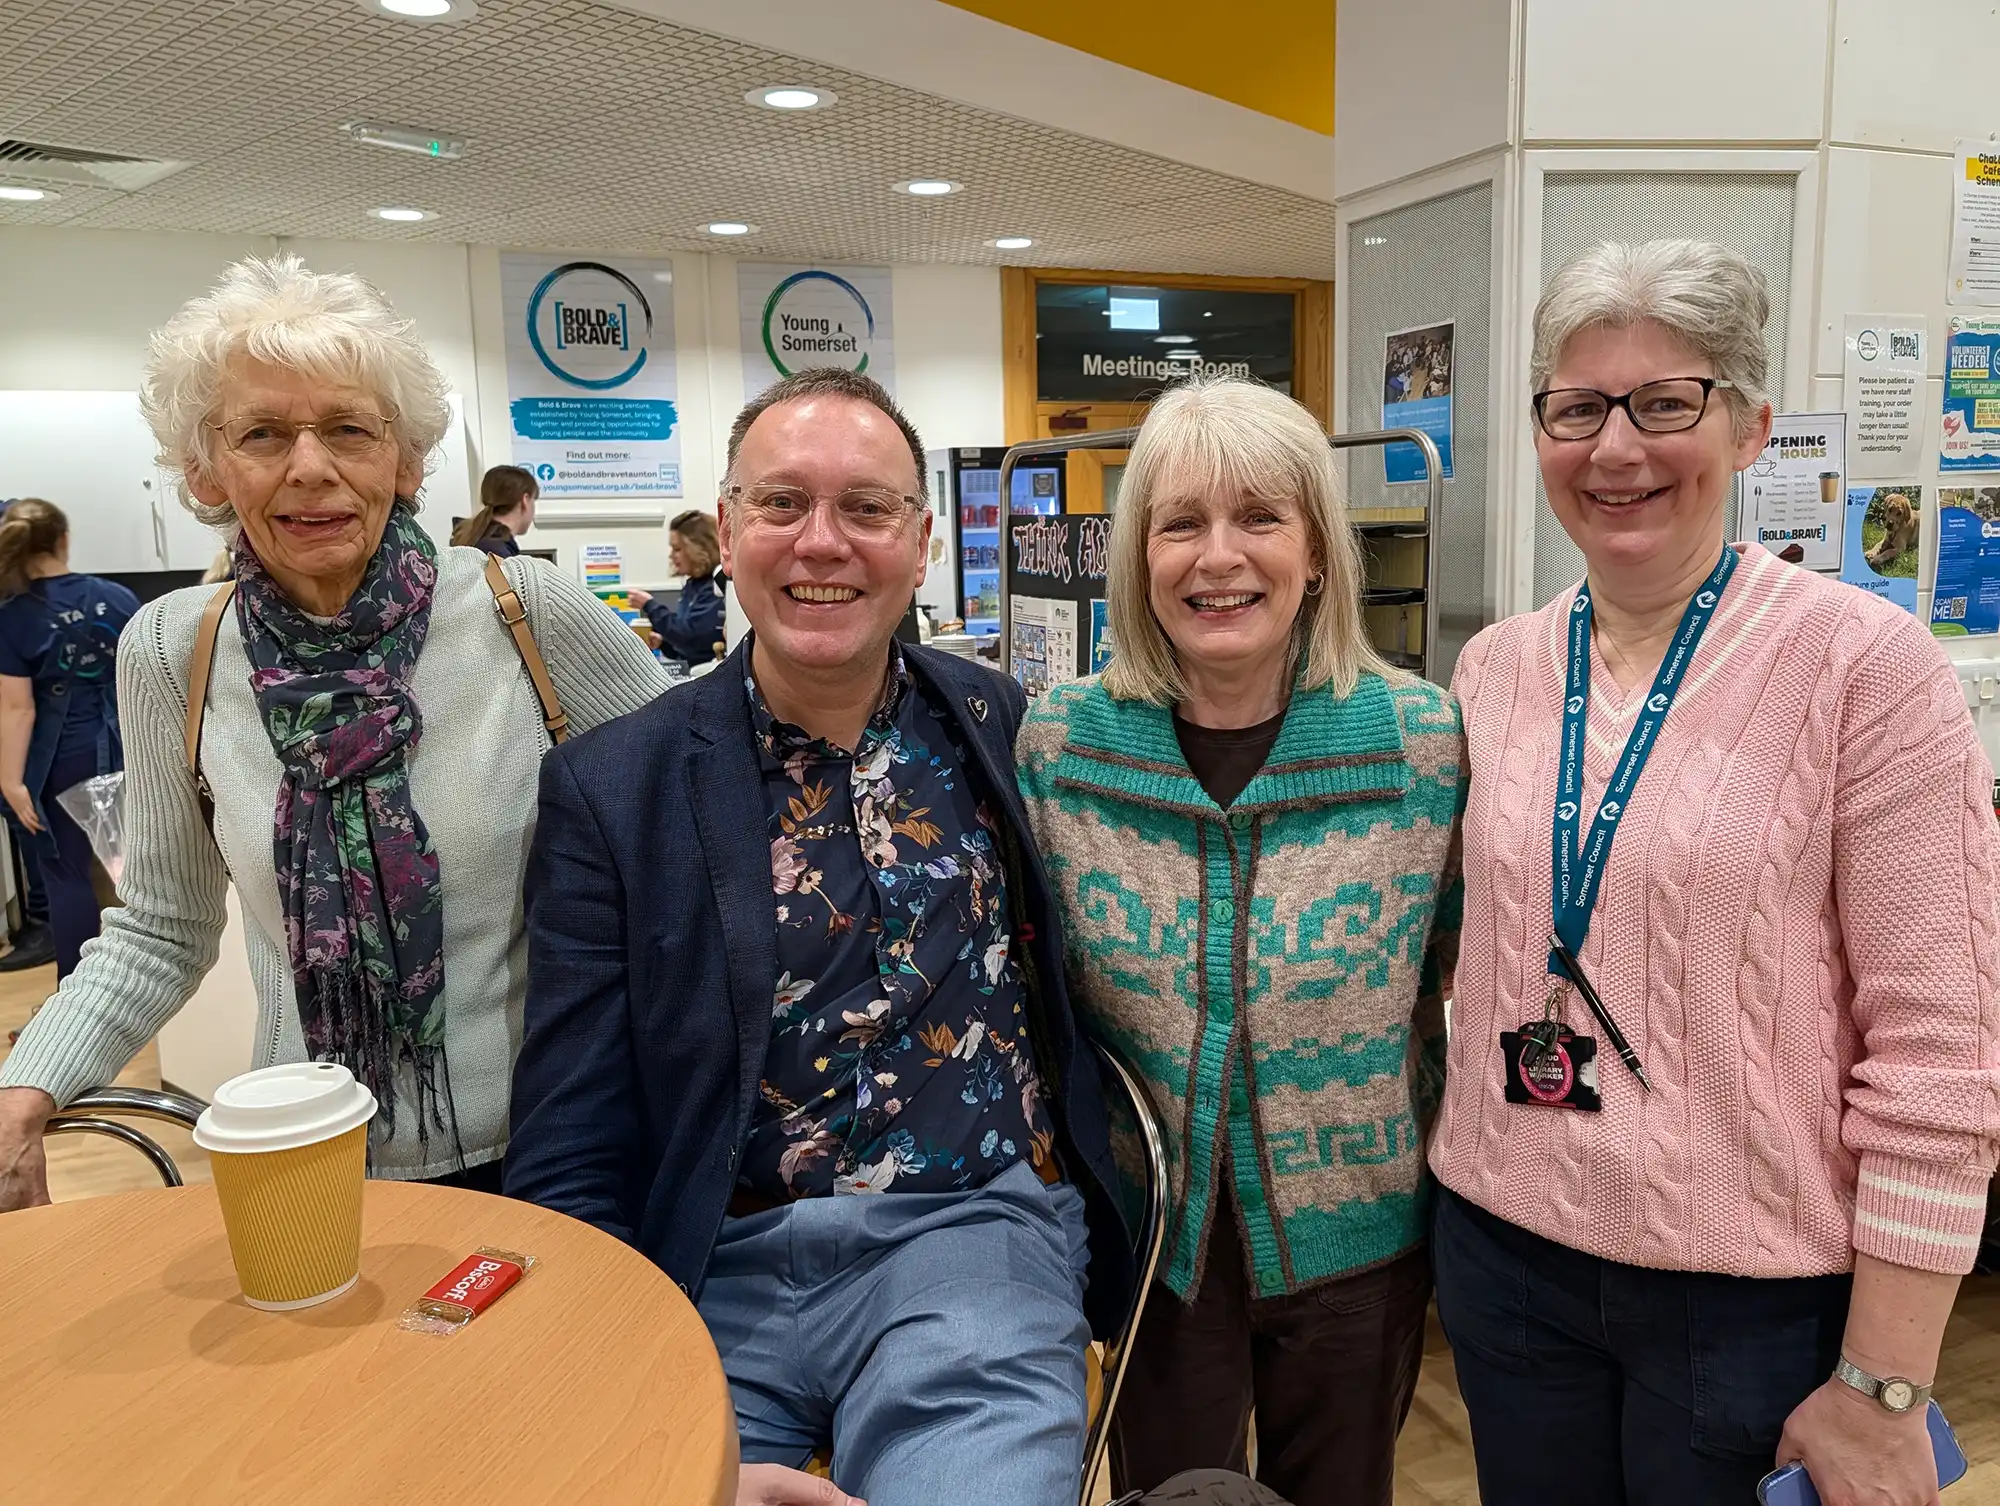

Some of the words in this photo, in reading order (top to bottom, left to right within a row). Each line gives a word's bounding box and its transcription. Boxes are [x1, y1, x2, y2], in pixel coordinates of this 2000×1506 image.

[781, 314, 830, 336] Young
[563, 327, 622, 345] BRAVE
[782, 334, 857, 352] Somerset
[1951, 346, 1986, 356] VOLUNTEERS
[1083, 354, 1181, 381] Meetings
[1190, 357, 1250, 378] Room
[1887, 377, 1907, 385] patient
[1859, 422, 1878, 430] longer
[1762, 435, 1826, 448] OPENING
[1887, 432, 1895, 440] for
[566, 452, 586, 460] Find
[1780, 447, 1827, 459] HOURS
[1870, 579, 1889, 590] guide
[1936, 598, 1951, 606] SCAN
[1933, 606, 1950, 620] ME
[1575, 619, 1584, 658] Somerset
[1663, 646, 1686, 686] Somerset
[1681, 615, 1702, 646] Council
[1573, 659, 1582, 688] Council
[1569, 722, 1578, 760] Somerset
[1615, 753, 1639, 793] Somerset
[1633, 720, 1654, 753] Council
[1565, 761, 1576, 793] Council
[1561, 829, 1571, 872] Somerset
[1576, 862, 1596, 907] Somerset
[1588, 829, 1607, 863] Council
[1529, 1066, 1563, 1074] LIRARY
[443, 1260, 502, 1301] Biscoff
